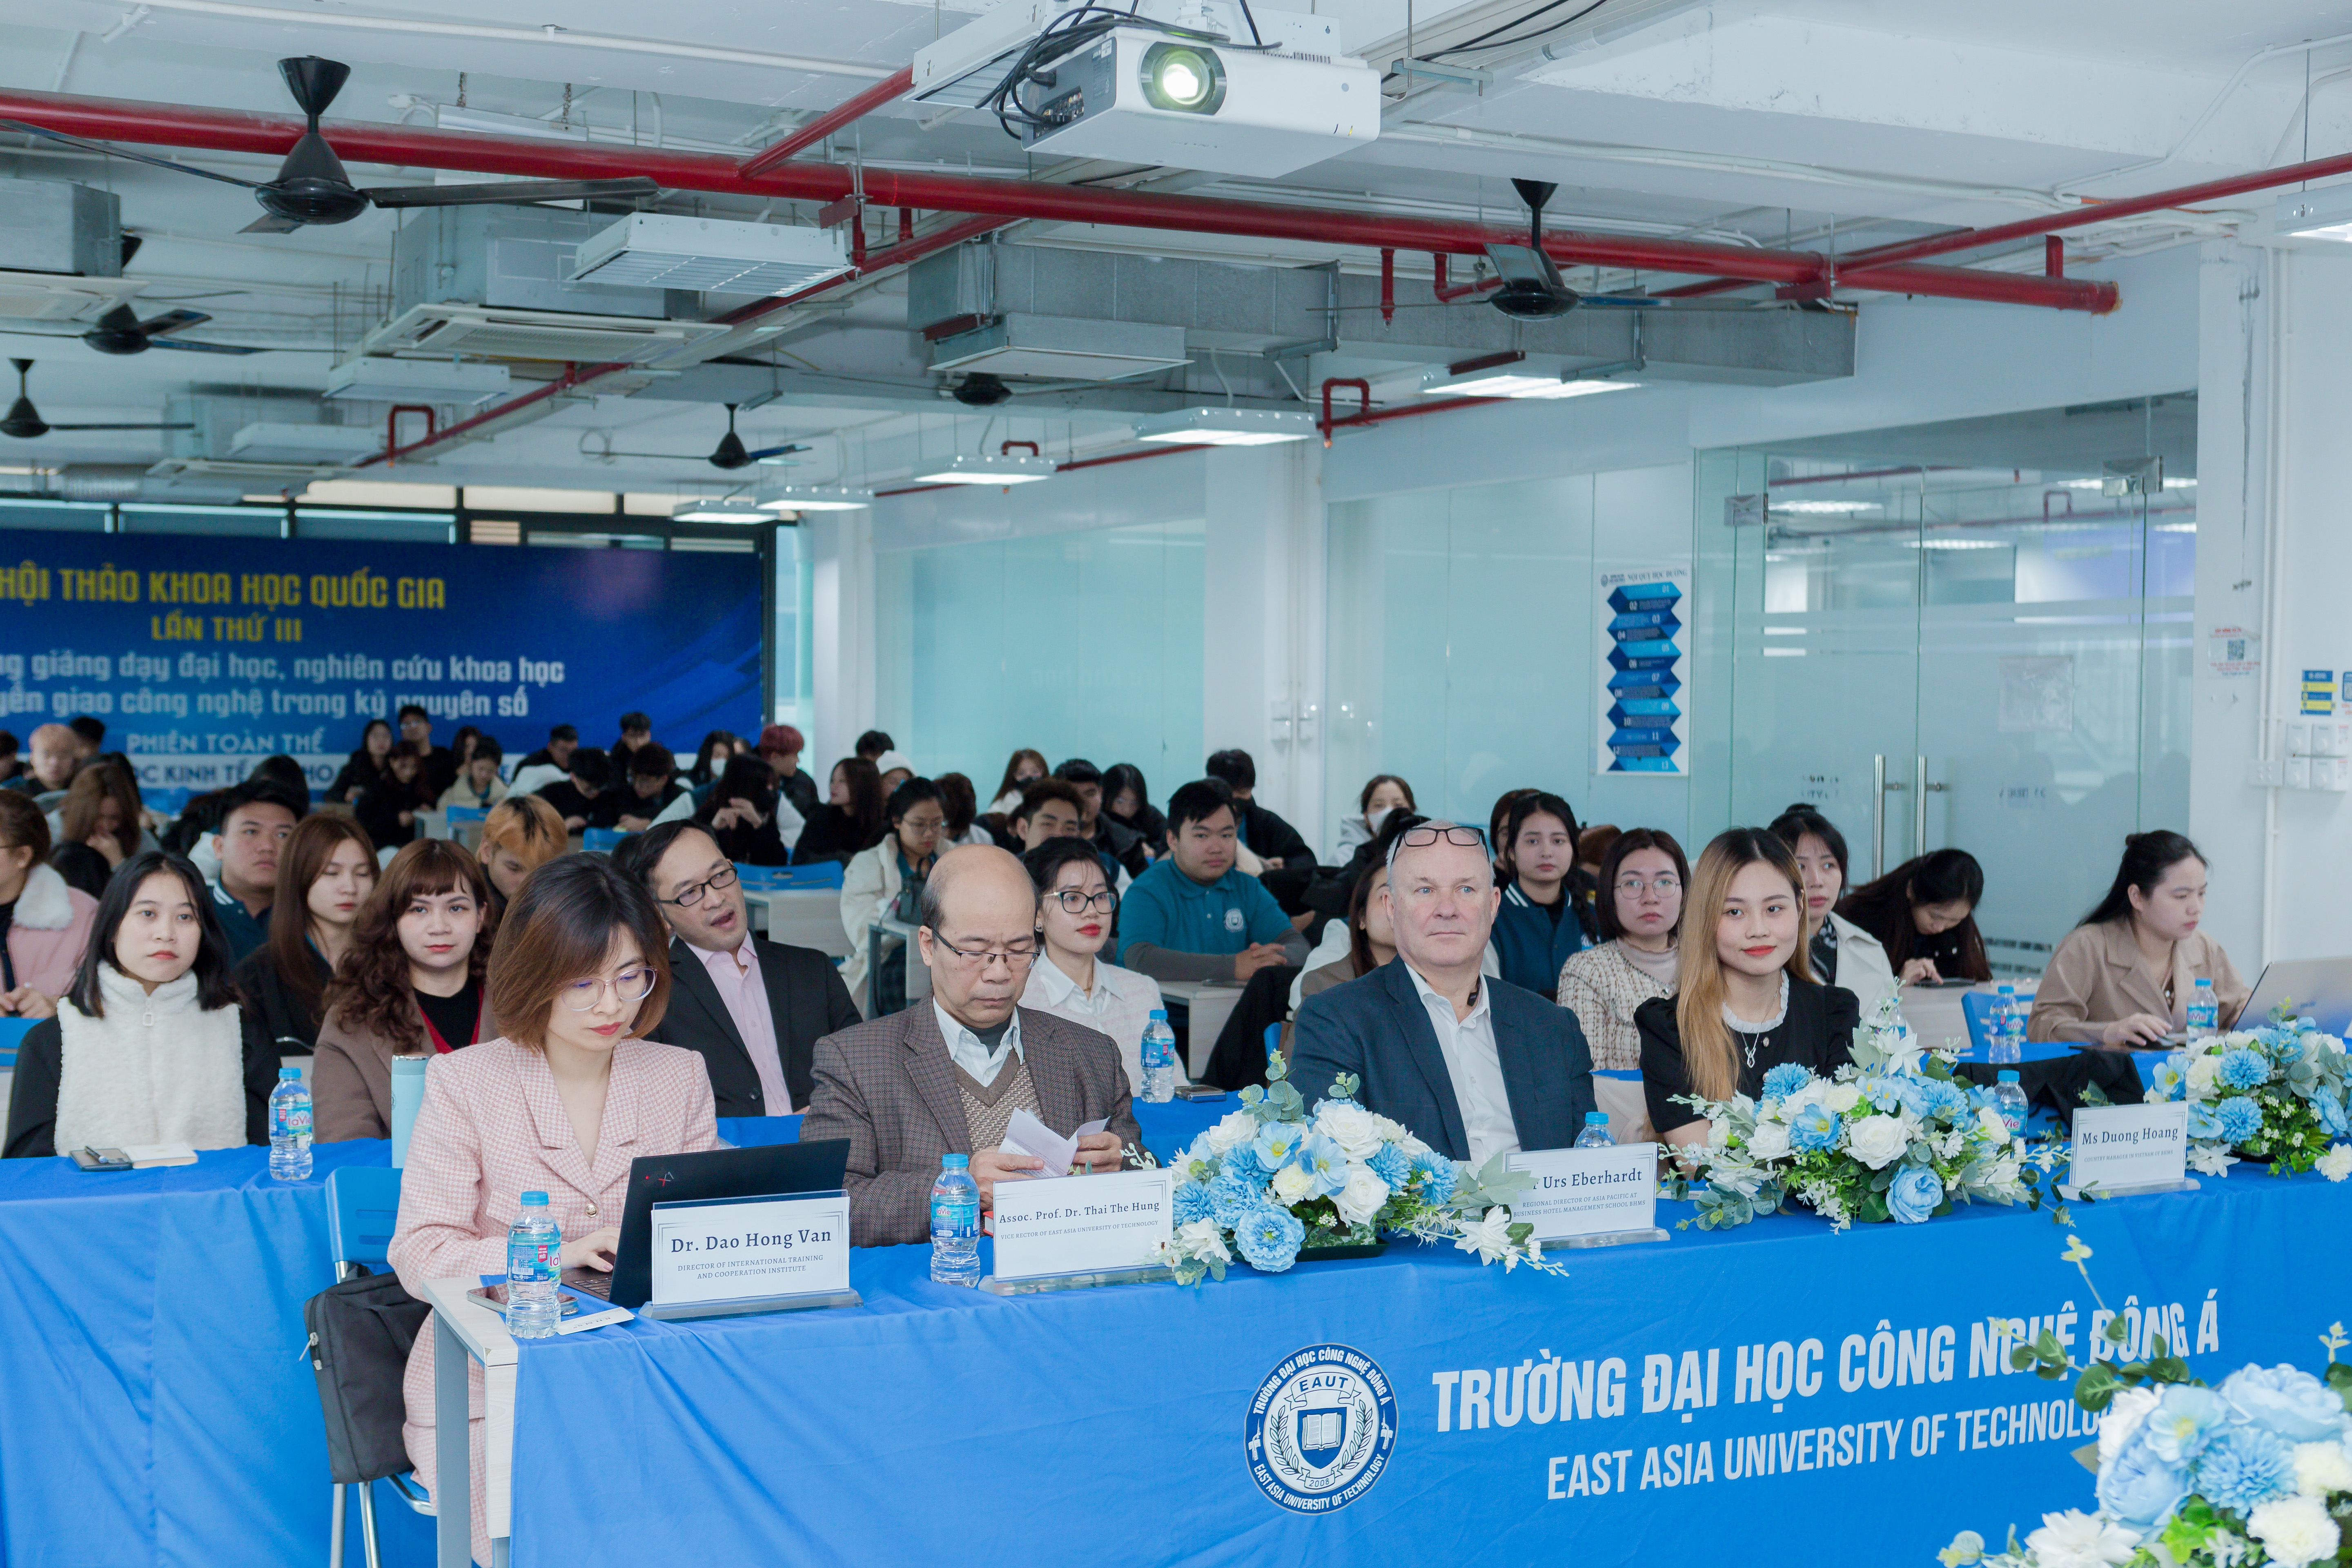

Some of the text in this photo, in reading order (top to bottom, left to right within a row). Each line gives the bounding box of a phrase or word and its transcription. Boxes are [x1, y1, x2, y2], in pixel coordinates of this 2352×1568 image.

[58, 562, 140, 603] THẢO
[149, 571, 232, 604] KHOA
[241, 573, 301, 612] HỌC
[310, 566, 389, 609] QUỐC
[396, 577, 446, 609] GIA
[275, 618, 302, 642] III
[31, 648, 110, 681] giảng
[118, 651, 170, 682] dạy
[177, 652, 220, 683] đại
[228, 652, 285, 683] học,
[294, 653, 384, 684] nghiên
[391, 654, 443, 681] cứu
[450, 655, 512, 682] khoa
[519, 655, 565, 688] học
[52, 687, 113, 717] giao
[120, 687, 188, 719] công
[197, 687, 263, 719] nghệ
[271, 689, 346, 719] trong
[497, 685, 529, 717] số
[126, 730, 198, 754] PHIÊN
[206, 729, 275, 754] TOÀN
[164, 764, 218, 783] KINH
[2082, 1127, 2178, 1145] Ms Duong Hoang
[1543, 1176, 1567, 1189] Urs
[1571, 1167, 1642, 1187] Eberhardt
[999, 1202, 1160, 1223] Assoc. Prof. Dr. Thai The Hung
[1563, 1204, 1604, 1213] MANAGEMENT
[1078, 1225, 1111, 1233] UNIVERSITY
[1121, 1220, 1159, 1229] TECHNOLOGY
[671, 1229, 831, 1253] Dr. Dao Hong Van
[677, 1263, 715, 1272] DIRECTOR
[727, 1258, 787, 1267] INTERNATIONAL
[715, 1268, 766, 1278] COOPERATION
[768, 1265, 806, 1274] INSTITUTE
[1432, 1349, 1627, 1432] TRƯỜNG
[1642, 1348, 1719, 1423] ĐẠI
[1734, 1338, 1824, 1413] HỌC
[1838, 1319, 1955, 1393] CÔNG
[2196, 1288, 2219, 1355] Á
[1253, 1347, 1392, 1414] TRƯỜNG ĐẠI HỌC CÔNG NGHỆ ĐÔNG Á
[1299, 1376, 1348, 1392] EAUT
[1548, 1449, 1633, 1500] EAST
[1639, 1441, 1714, 1491] ASIA
[1724, 1419, 1902, 1481] UNIVERSITY
[1910, 1413, 1948, 1458] OF
[1254, 1453, 1385, 1510] EAST ASIA UNIVERSITY OF TECHNOLOGY
[1309, 1479, 1330, 1487] 2008
